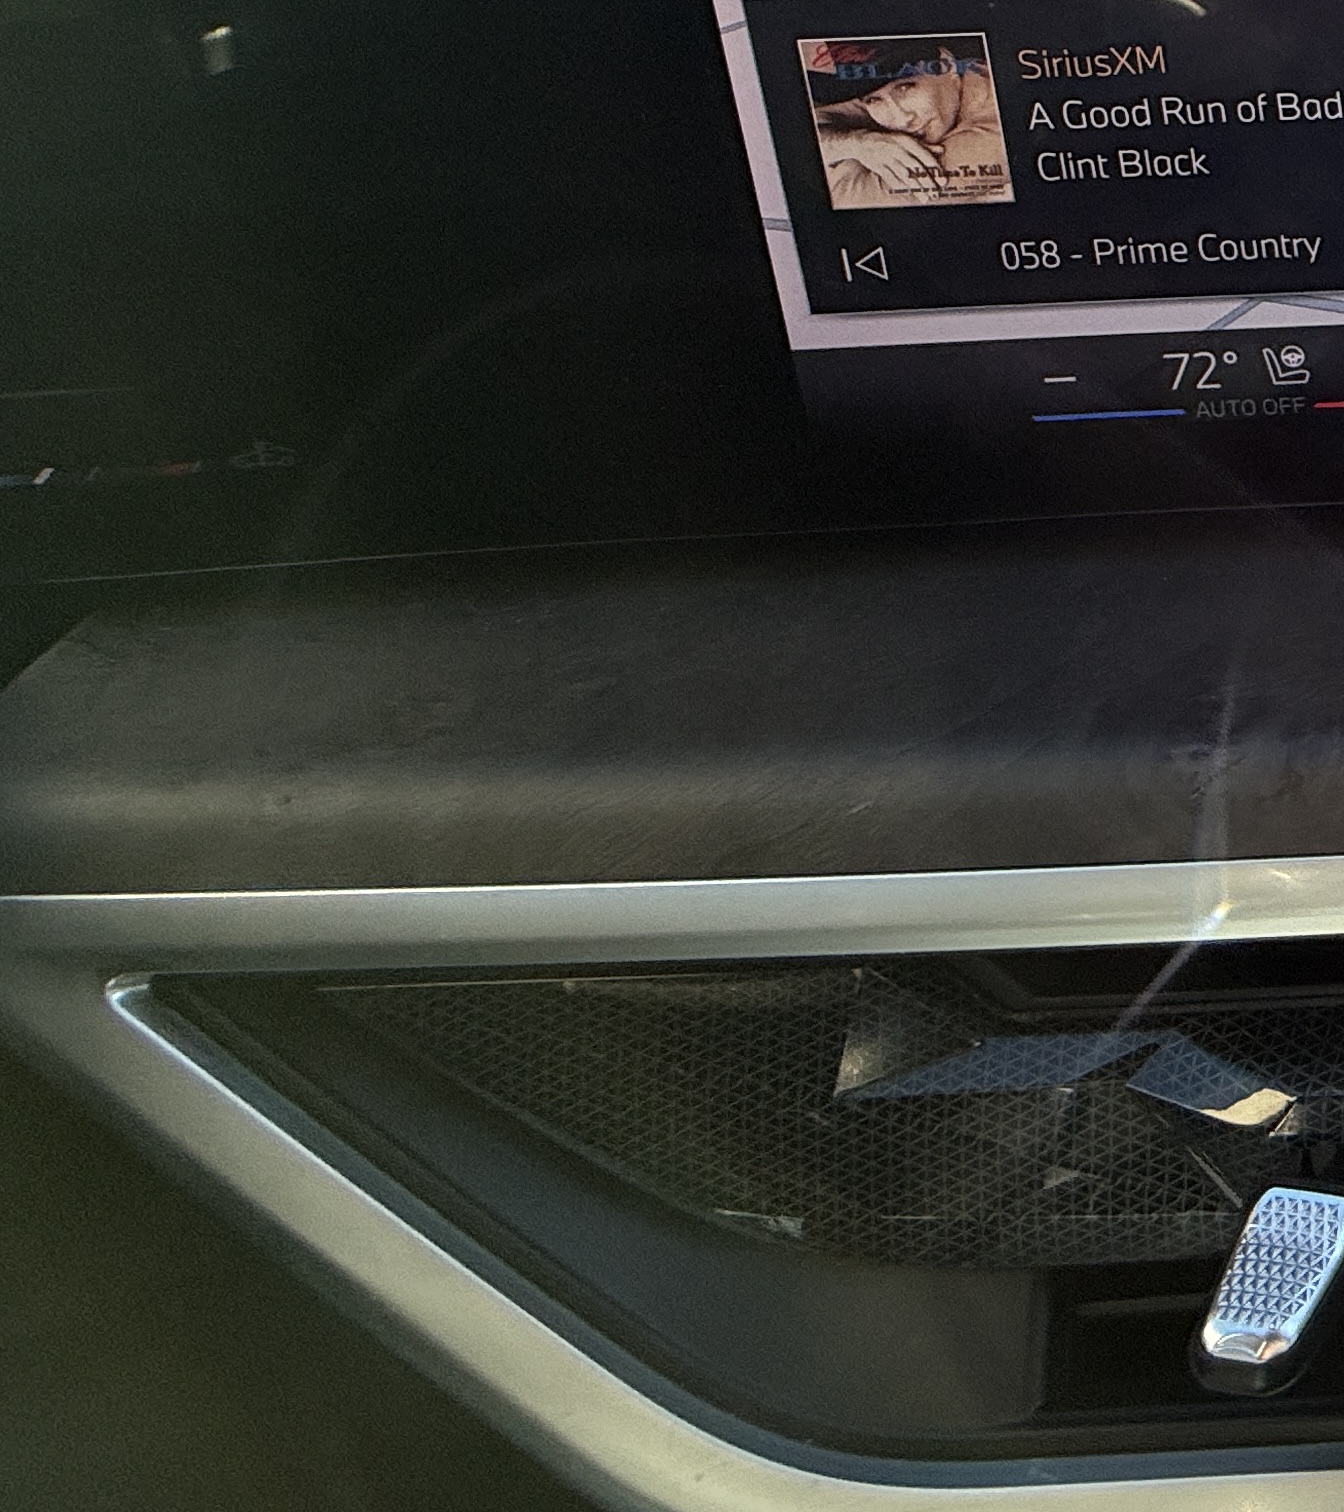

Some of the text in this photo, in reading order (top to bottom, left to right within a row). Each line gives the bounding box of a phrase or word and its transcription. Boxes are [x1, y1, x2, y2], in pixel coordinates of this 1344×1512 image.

[1017, 45, 1167, 82] SiriusXM
[1028, 101, 1054, 131] A
[1061, 97, 1152, 131] Good
[1163, 95, 1227, 128] Run
[1234, 91, 1270, 125] of
[1278, 90, 1344, 124] Bad
[1037, 145, 1211, 183] Clint Black
[1000, 239, 1062, 271] 058
[1093, 235, 1189, 268] Prime
[1198, 232, 1323, 264] Country
[1196, 396, 1306, 419] AUTO OFF
